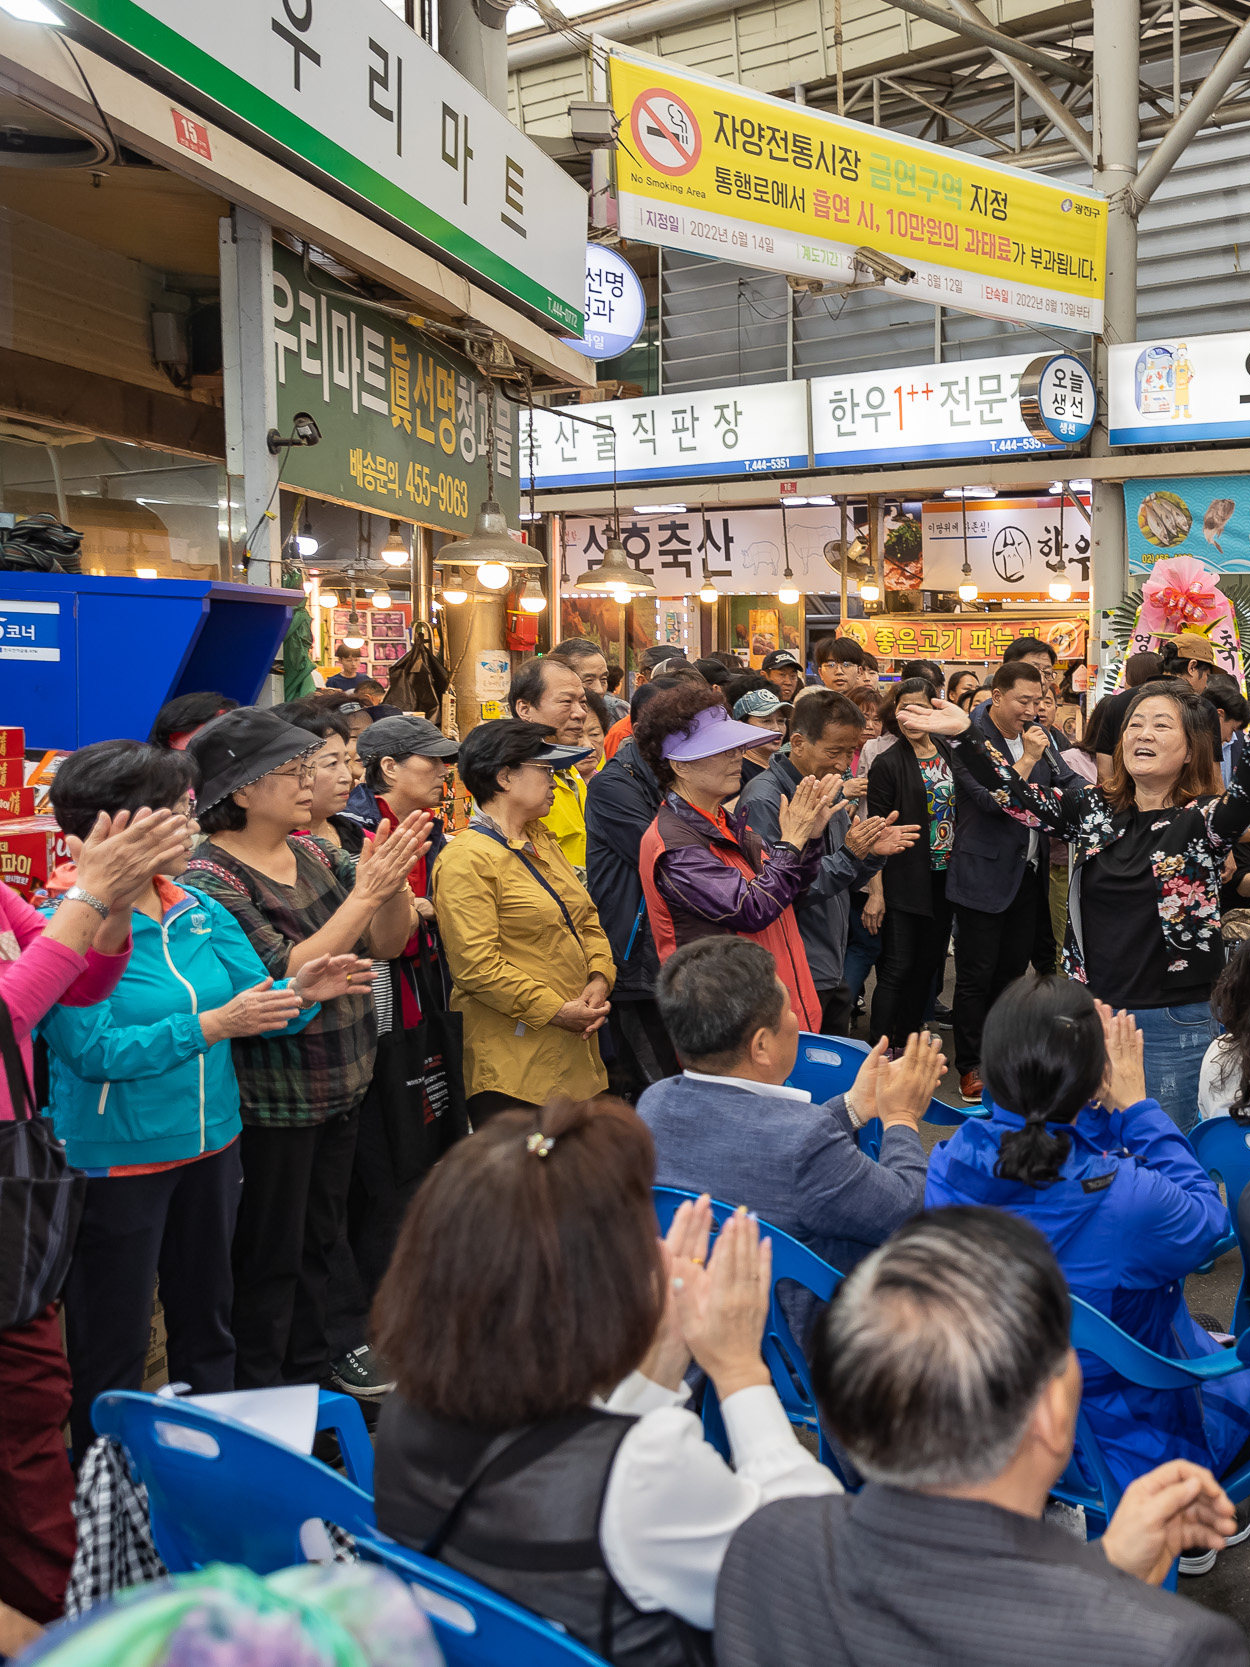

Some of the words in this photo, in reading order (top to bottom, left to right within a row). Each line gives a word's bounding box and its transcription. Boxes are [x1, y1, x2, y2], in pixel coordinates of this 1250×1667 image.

[181, 118, 198, 144] 15
[271, 0, 527, 239] 우리마트
[713, 111, 861, 182] 자양전통시장
[869, 151, 962, 211] 금연구역
[970, 183, 1008, 222] 지정
[630, 172, 644, 184] No
[646, 176, 684, 195] Smoking
[686, 187, 706, 199] Area
[1074, 203, 1101, 218] 광진구
[646, 210, 679, 232] 지정일
[690, 220, 728, 243] 2022년
[732, 230, 749, 247] 6월
[752, 234, 775, 253] 14일
[715, 166, 805, 213] 통행로에서
[813, 188, 850, 224] 흡연
[857, 200, 880, 233] 시,
[886, 208, 959, 250] 10만원의
[964, 227, 1026, 266] 과태료가
[1030, 246, 1098, 283] 부과됩니다.
[927, 273, 941, 289] 8월
[944, 277, 963, 294] 12일
[585, 296, 615, 323] 과
[1016, 293, 1043, 310] 2022년
[1045, 299, 1058, 314] 8월
[1060, 302, 1090, 319] 13일부터
[1052, 368, 1084, 394] 오늘
[1052, 392, 1083, 419] 생선
[520, 400, 742, 466] 축산물직판장
[1059, 422, 1076, 435] 생선
[744, 457, 790, 472] T.444-5351
[350, 447, 402, 499] 배송문의.
[405, 461, 469, 519] 455-9063
[970, 627, 1014, 656] 파는
[0, 853, 32, 876] 파이
